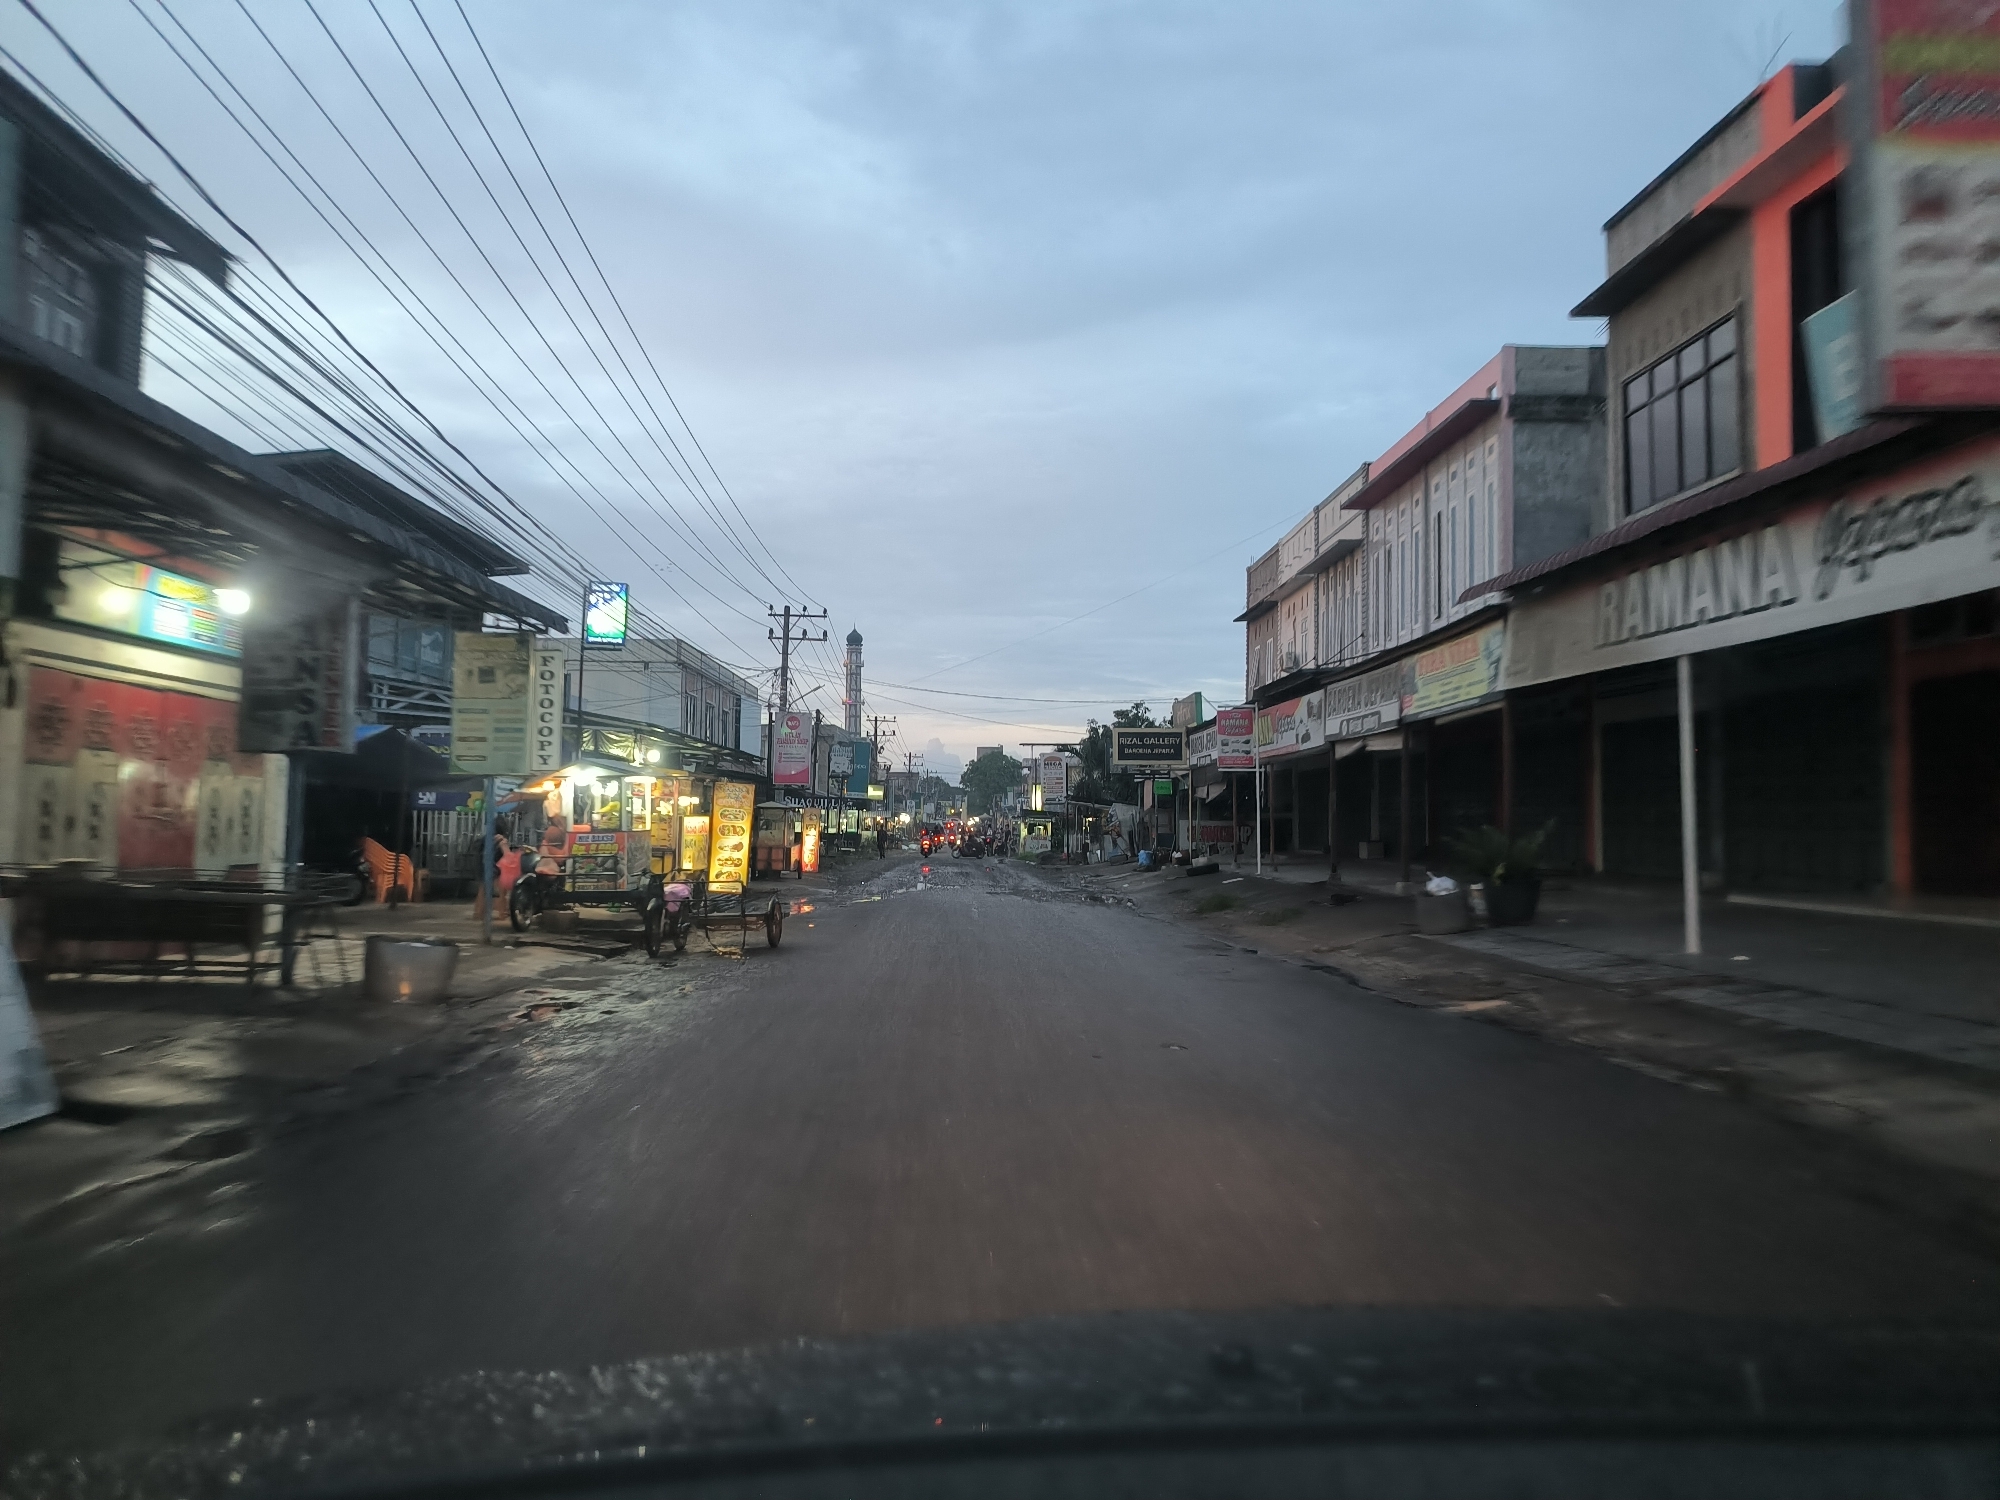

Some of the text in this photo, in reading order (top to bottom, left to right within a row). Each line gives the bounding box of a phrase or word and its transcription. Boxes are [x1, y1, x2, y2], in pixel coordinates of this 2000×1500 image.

[1594, 522, 1799, 648] RAMANA
[537, 655, 556, 766] FOTOCOPY
[1119, 737, 1181, 745] RIZAL GALLERY
